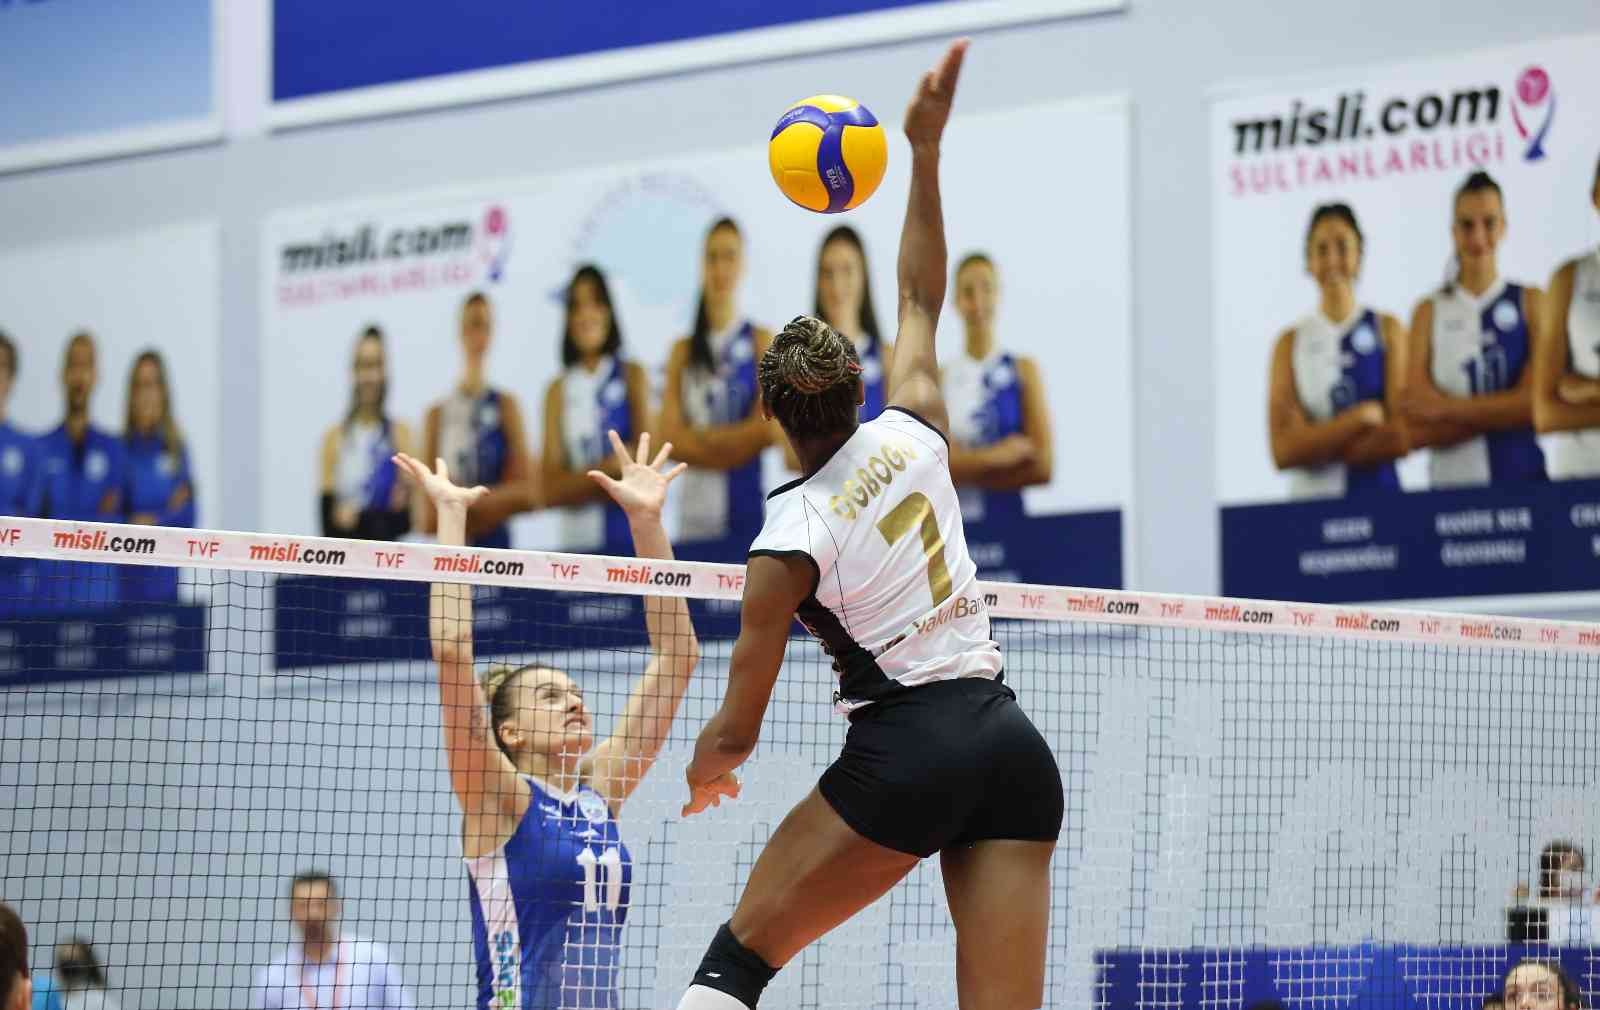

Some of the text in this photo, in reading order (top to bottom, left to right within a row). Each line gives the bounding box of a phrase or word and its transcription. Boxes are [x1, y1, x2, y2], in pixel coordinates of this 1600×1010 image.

[1232, 84, 1502, 153] misli.com
[53, 529, 156, 554] misli.com
[187, 540, 220, 559] TVF
[250, 542, 346, 565] misli.com
[375, 551, 405, 569] TVF
[433, 553, 524, 577] misli.com
[551, 563, 580, 581] TVF
[606, 565, 691, 587] misli.com
[717, 574, 744, 591] TVF
[876, 491, 952, 609] 7
[1021, 594, 1045, 609] TVF
[1066, 594, 1139, 615] misli.com
[1160, 603, 1184, 618] TVF
[1205, 604, 1273, 624] misli.com
[1293, 612, 1315, 627] TVF
[1335, 611, 1400, 632] misli.com
[1459, 621, 1521, 641] misli.com
[576, 848, 622, 912] 11
